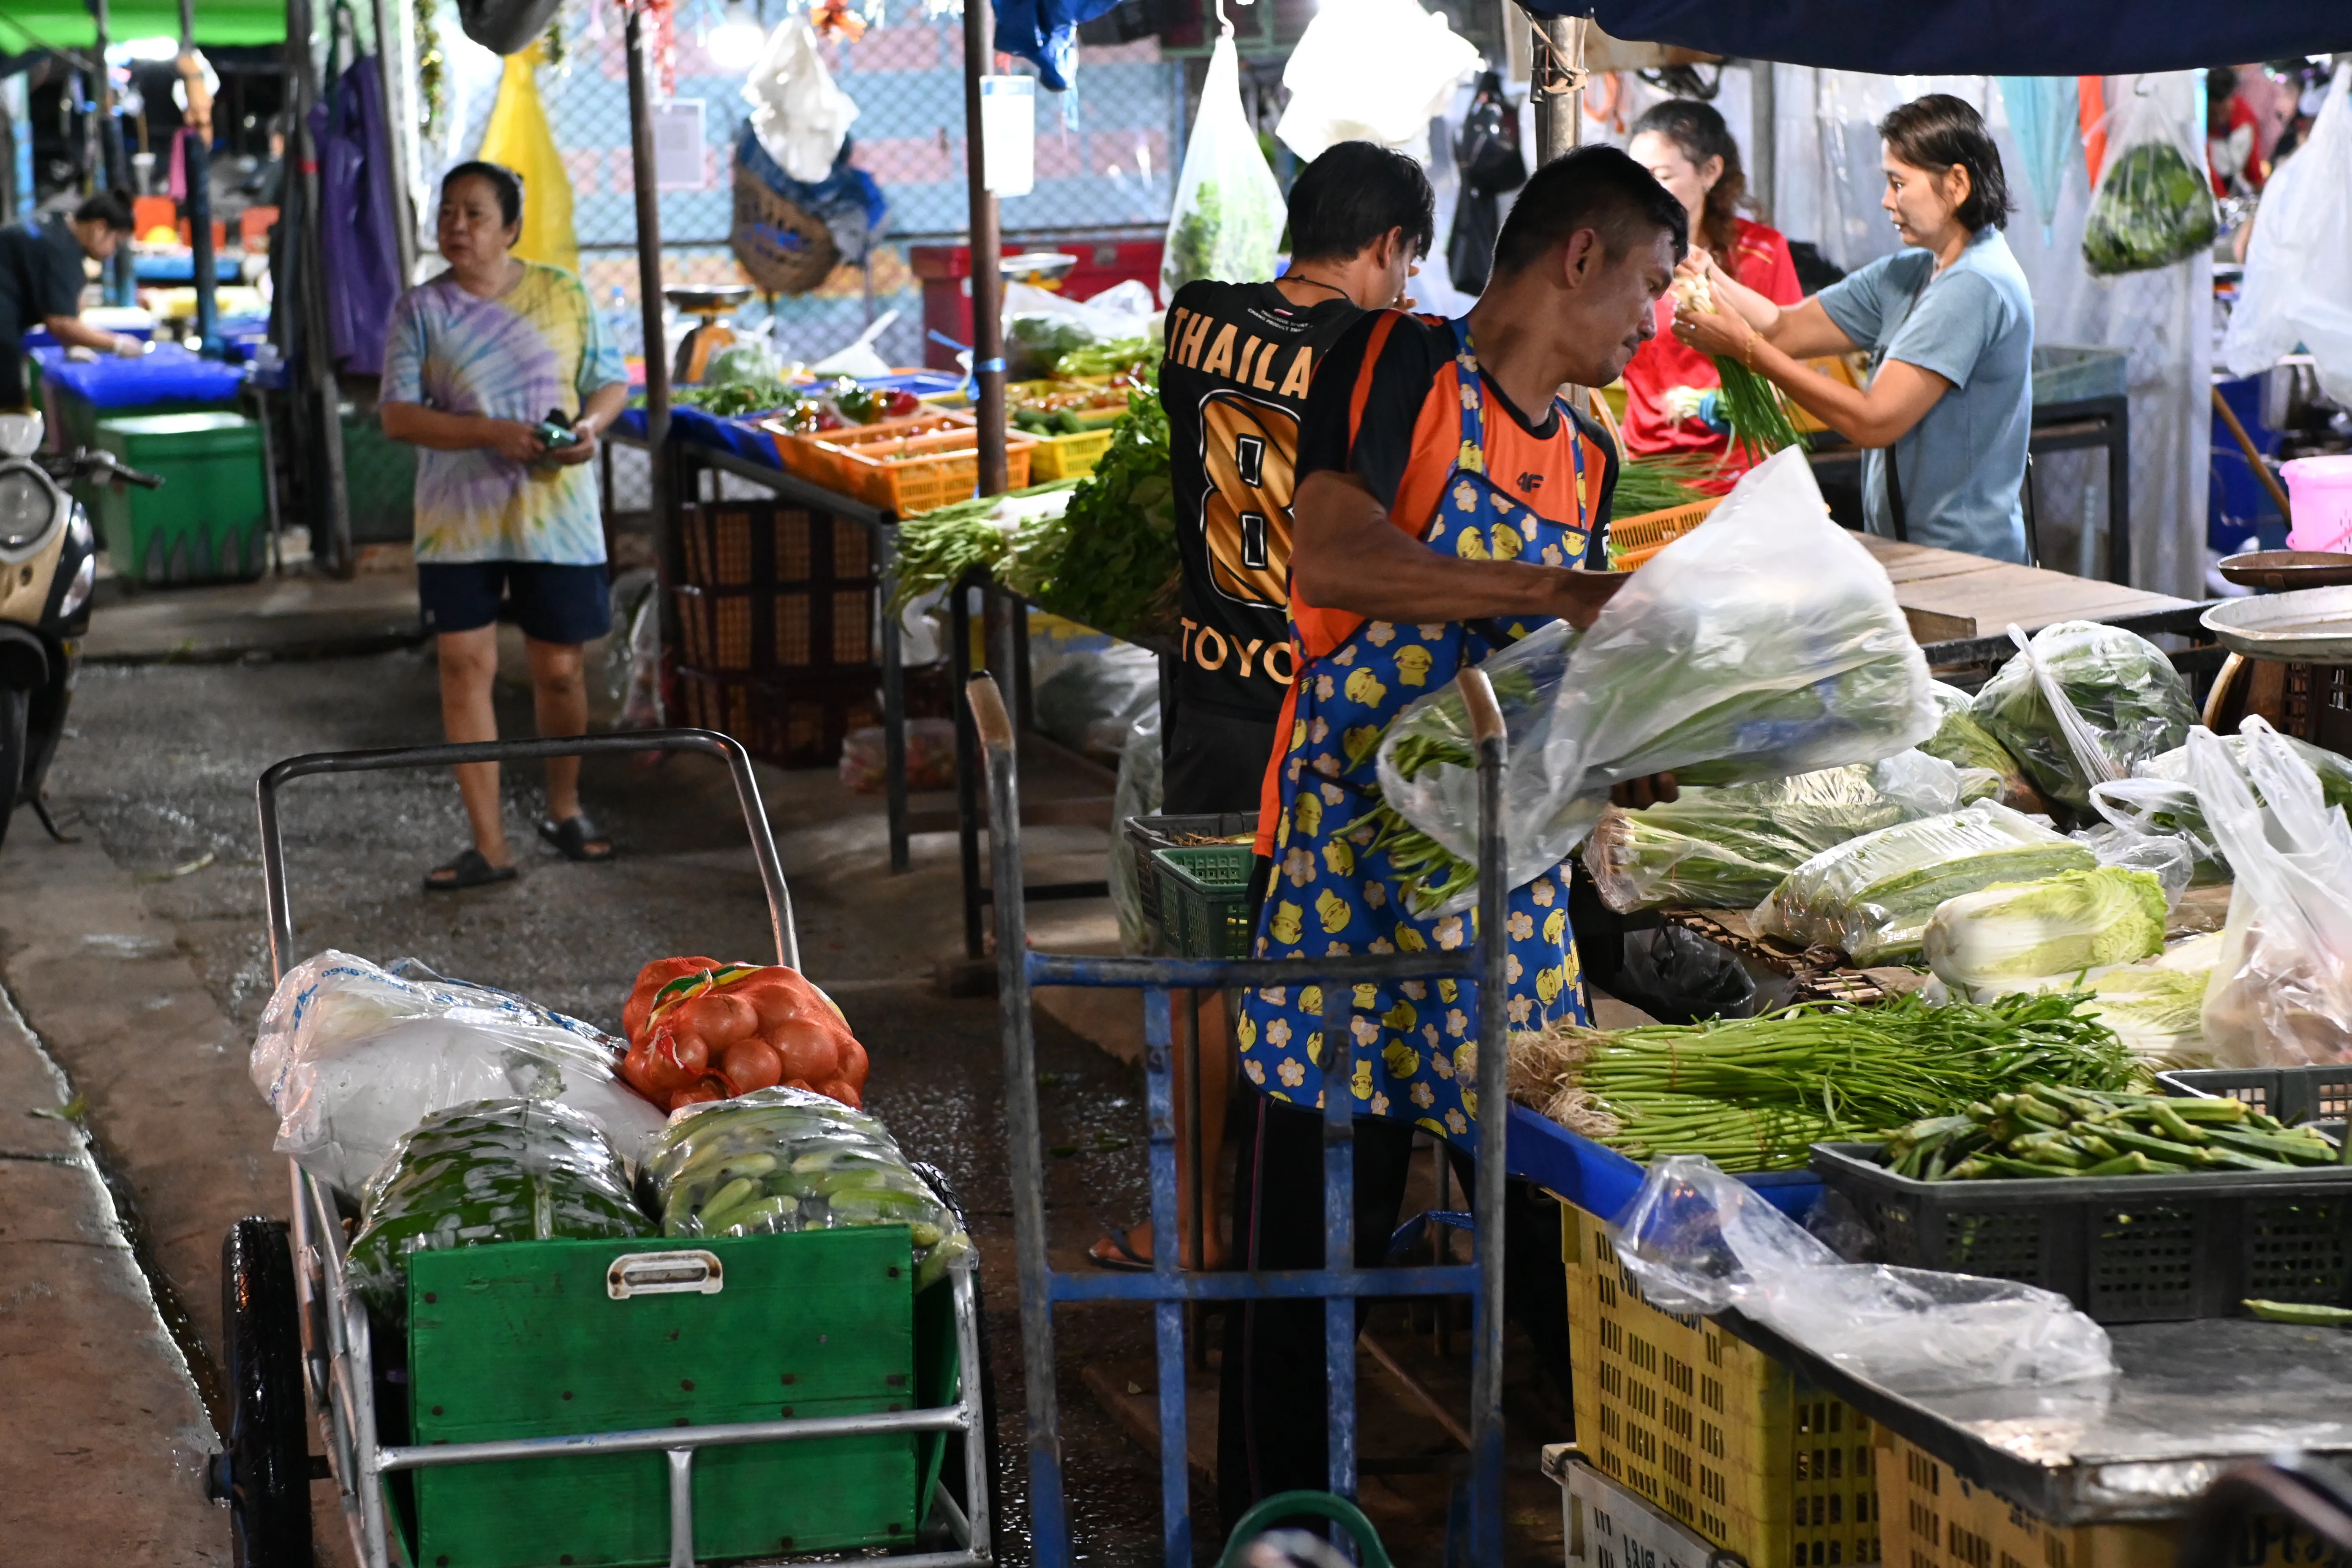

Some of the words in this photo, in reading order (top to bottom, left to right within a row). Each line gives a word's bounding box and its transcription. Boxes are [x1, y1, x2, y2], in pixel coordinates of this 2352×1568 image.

[1168, 306, 1312, 400] THAILA
[1199, 389, 1301, 612] 8
[1516, 471, 1545, 493] 4F
[1181, 617, 1294, 685] TOYO
